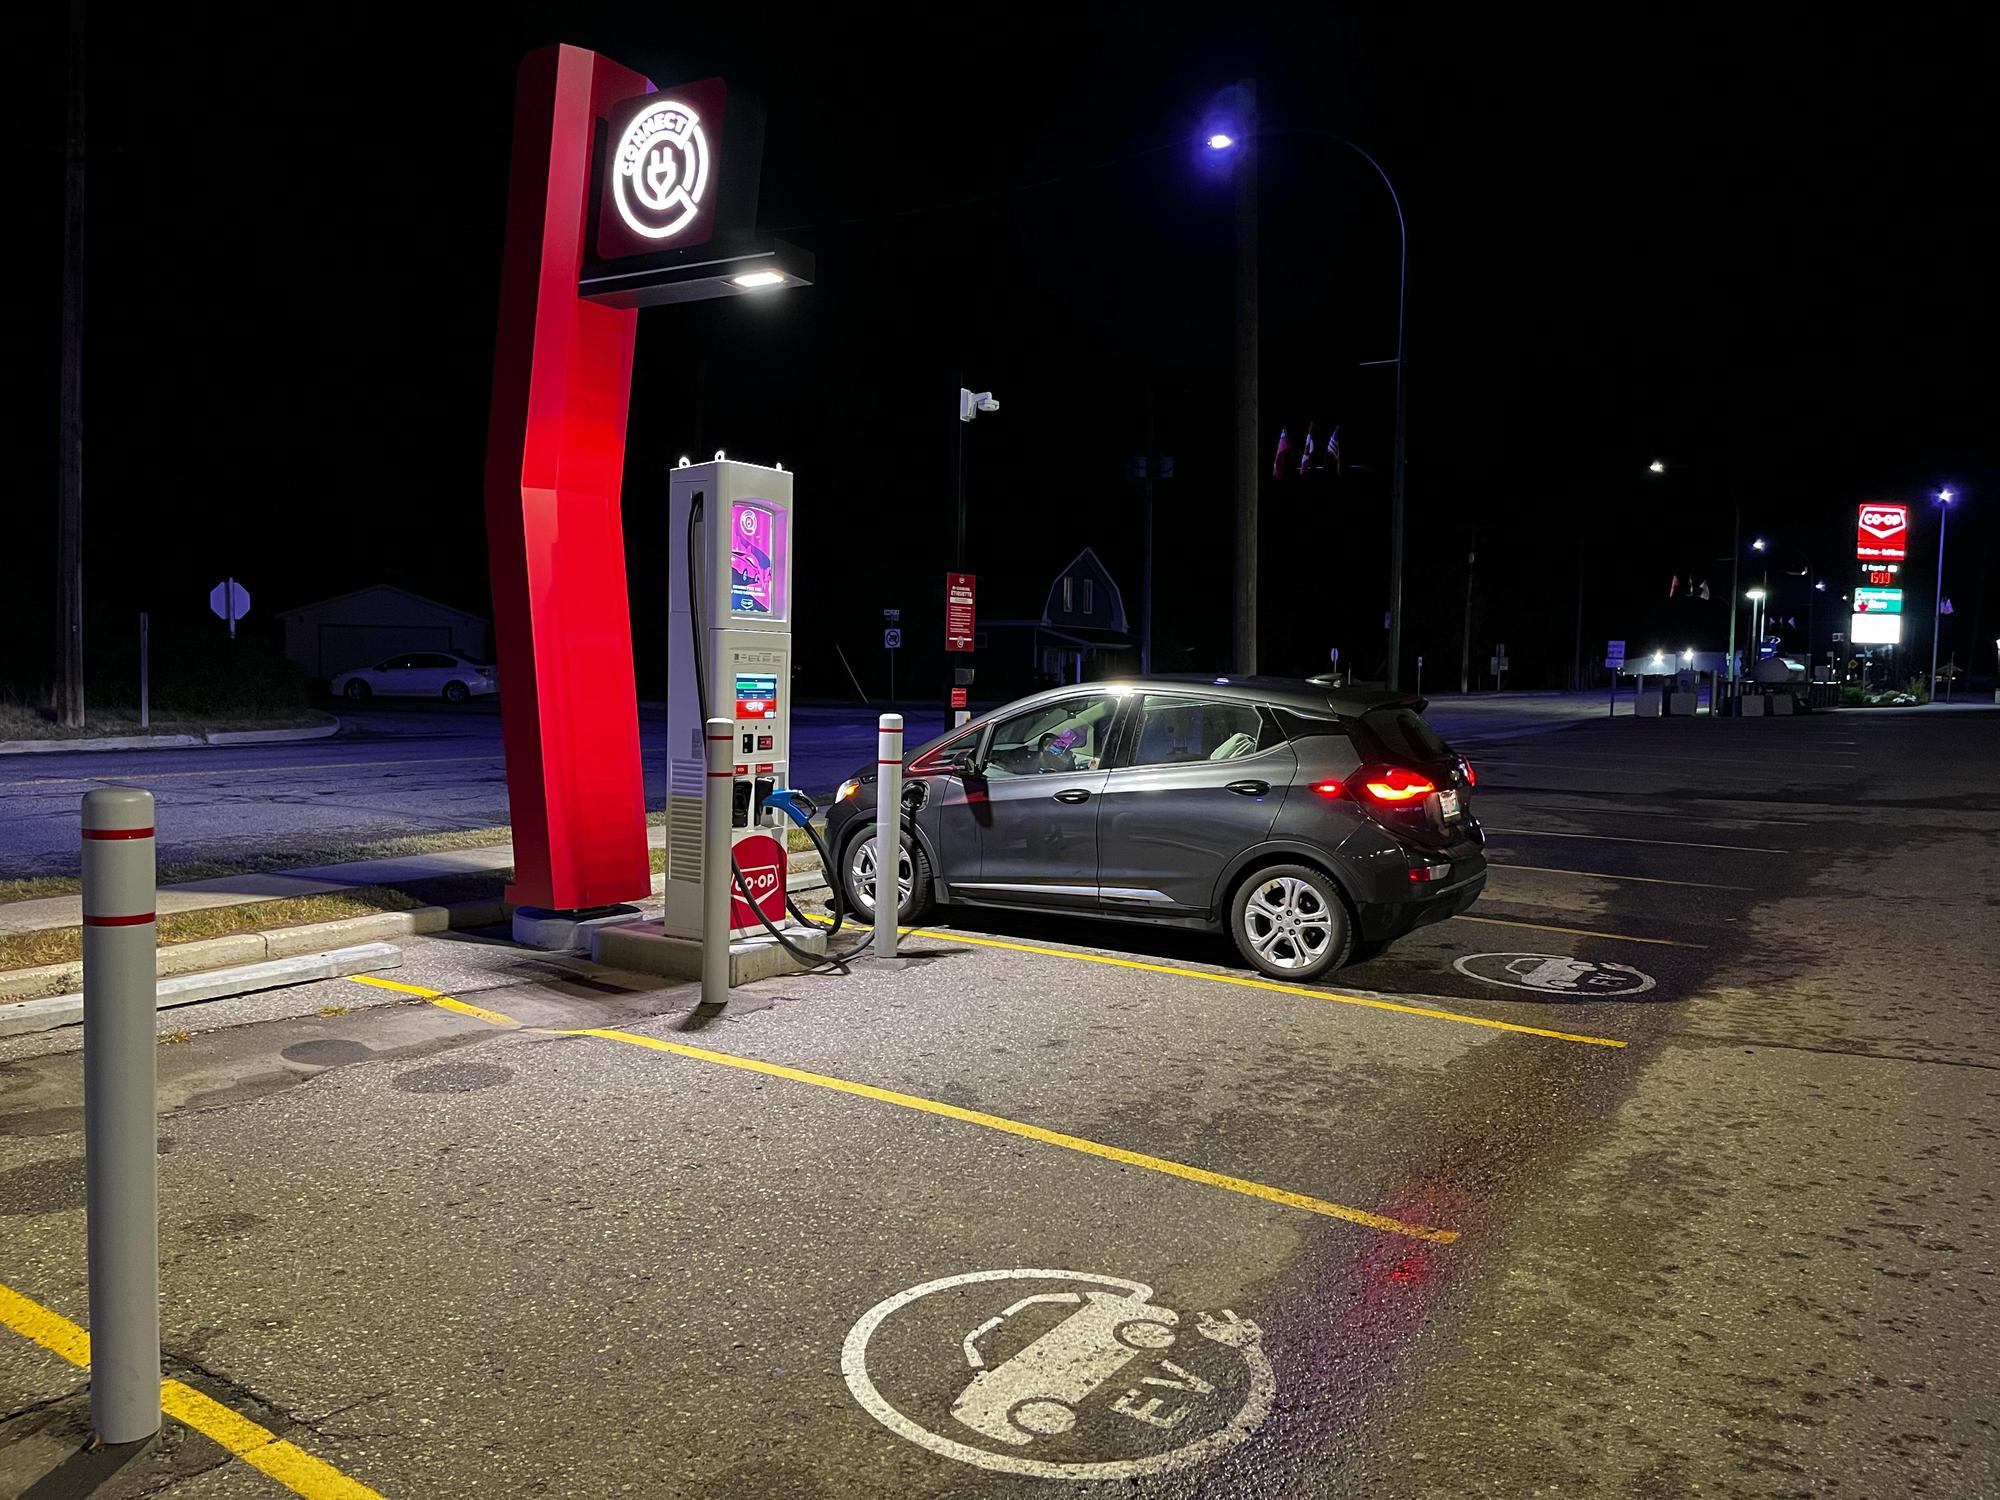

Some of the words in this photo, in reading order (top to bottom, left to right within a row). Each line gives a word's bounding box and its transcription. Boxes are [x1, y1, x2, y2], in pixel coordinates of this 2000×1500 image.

[621, 112, 688, 176] CONNECT
[1864, 513, 1901, 526] CO-OP
[1587, 972, 1628, 987] EV
[1108, 1359, 1216, 1429] EV
